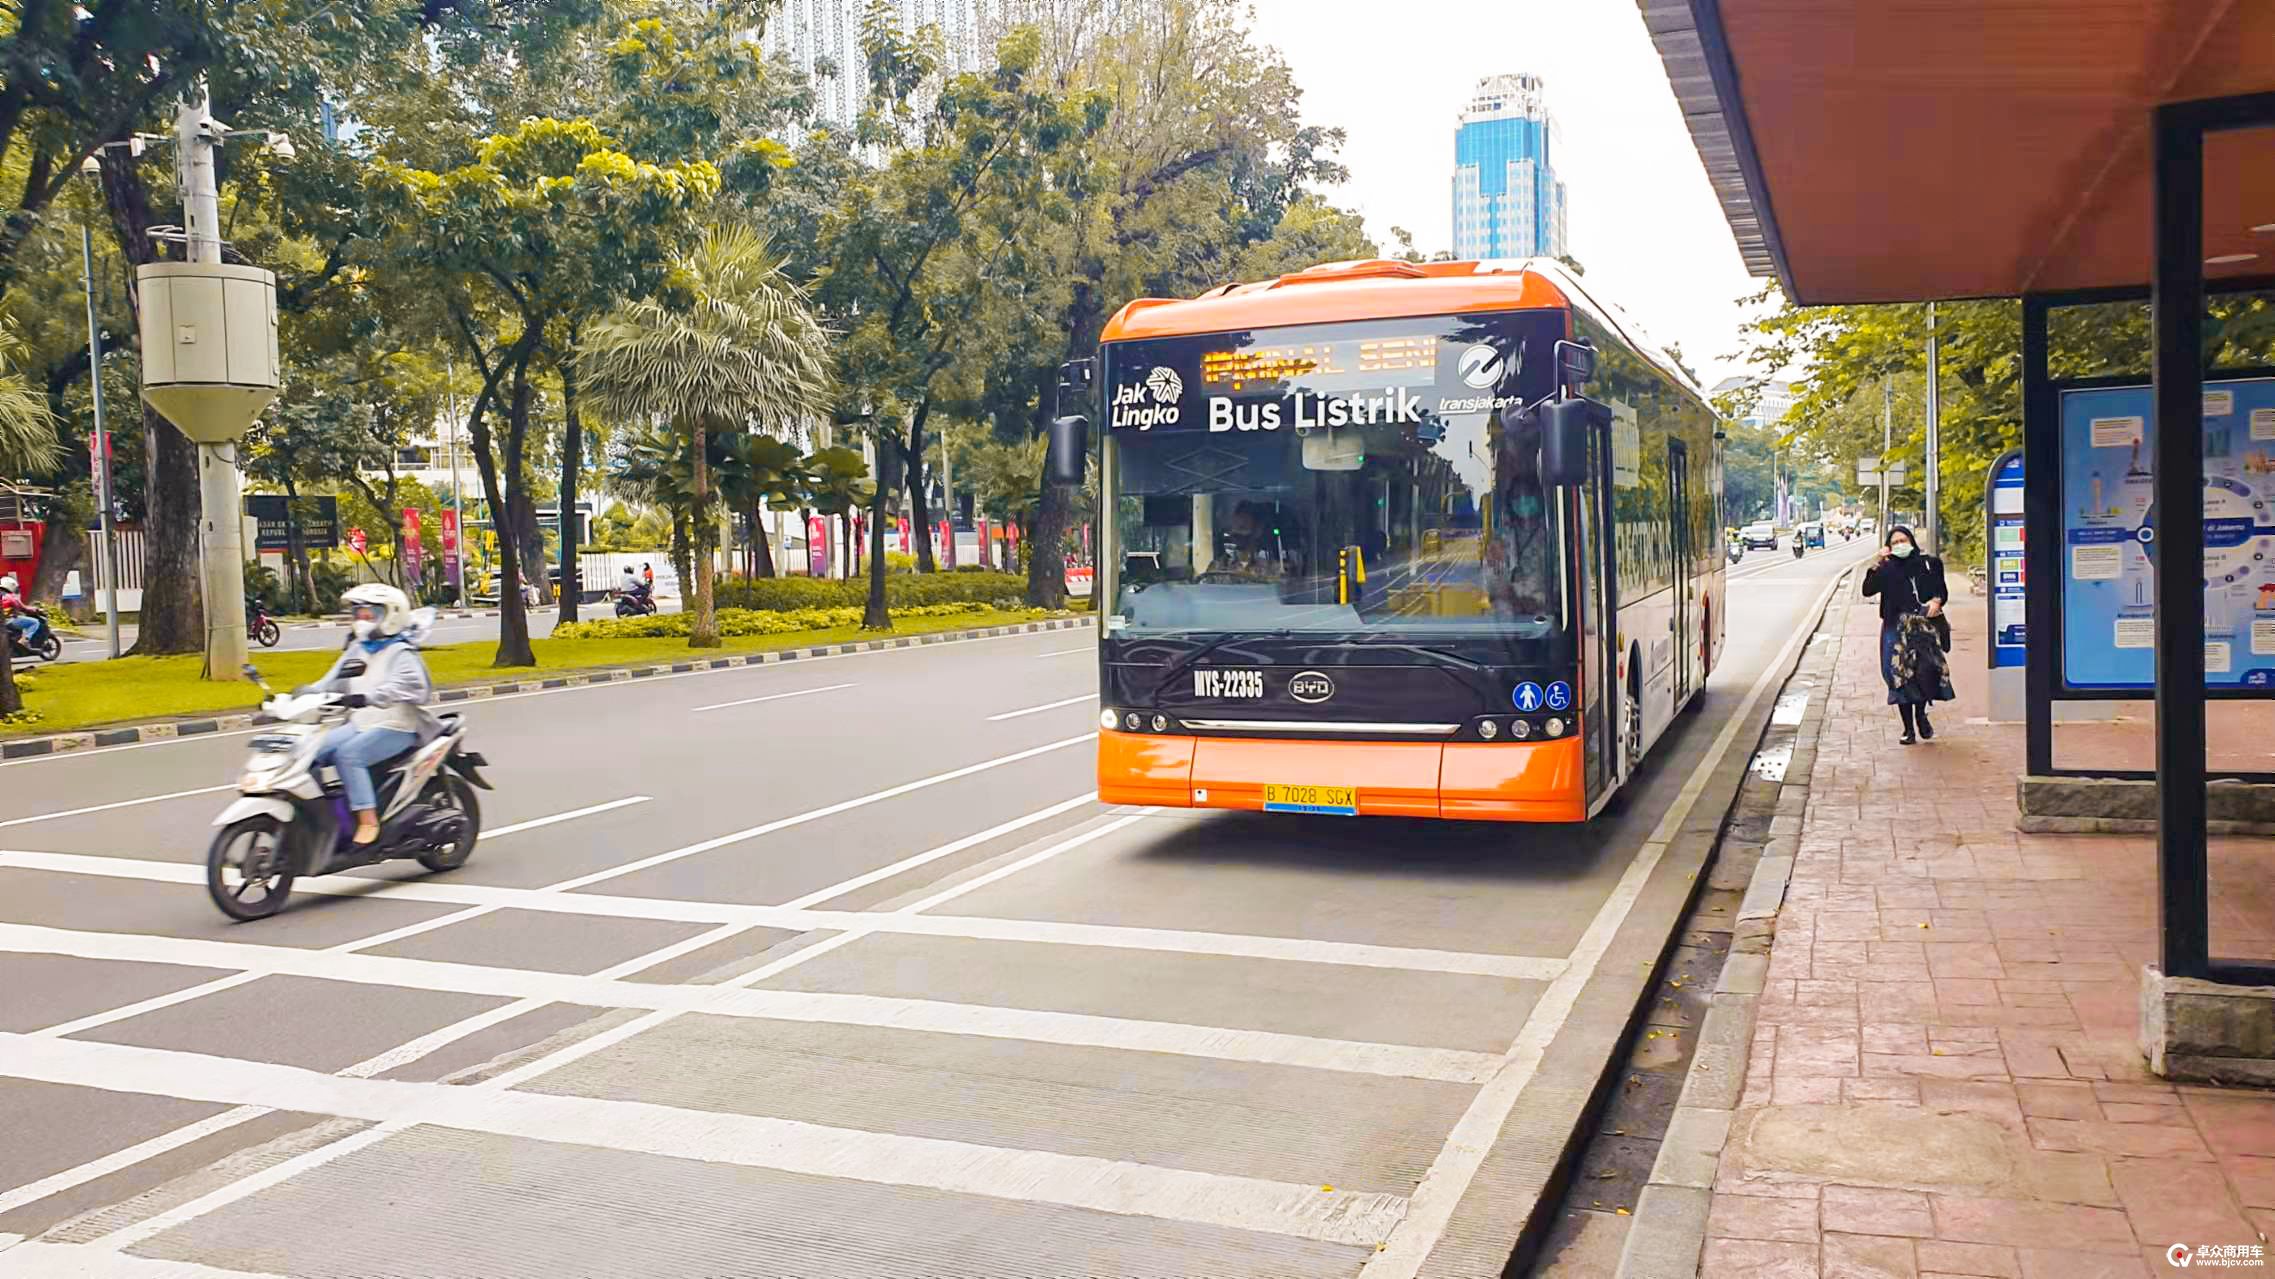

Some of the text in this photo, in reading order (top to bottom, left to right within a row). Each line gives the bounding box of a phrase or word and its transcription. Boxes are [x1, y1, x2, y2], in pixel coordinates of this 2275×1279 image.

[1112, 382, 1147, 406] Jak
[1438, 395, 1523, 414] transjakarta
[1112, 403, 1179, 431] Lingko
[1209, 386, 1422, 432] Bus Listrik
[1194, 670, 1264, 698] MYS-22335
[1293, 680, 1329, 694] BYD
[1267, 786, 1353, 806] B 7028 SGX
